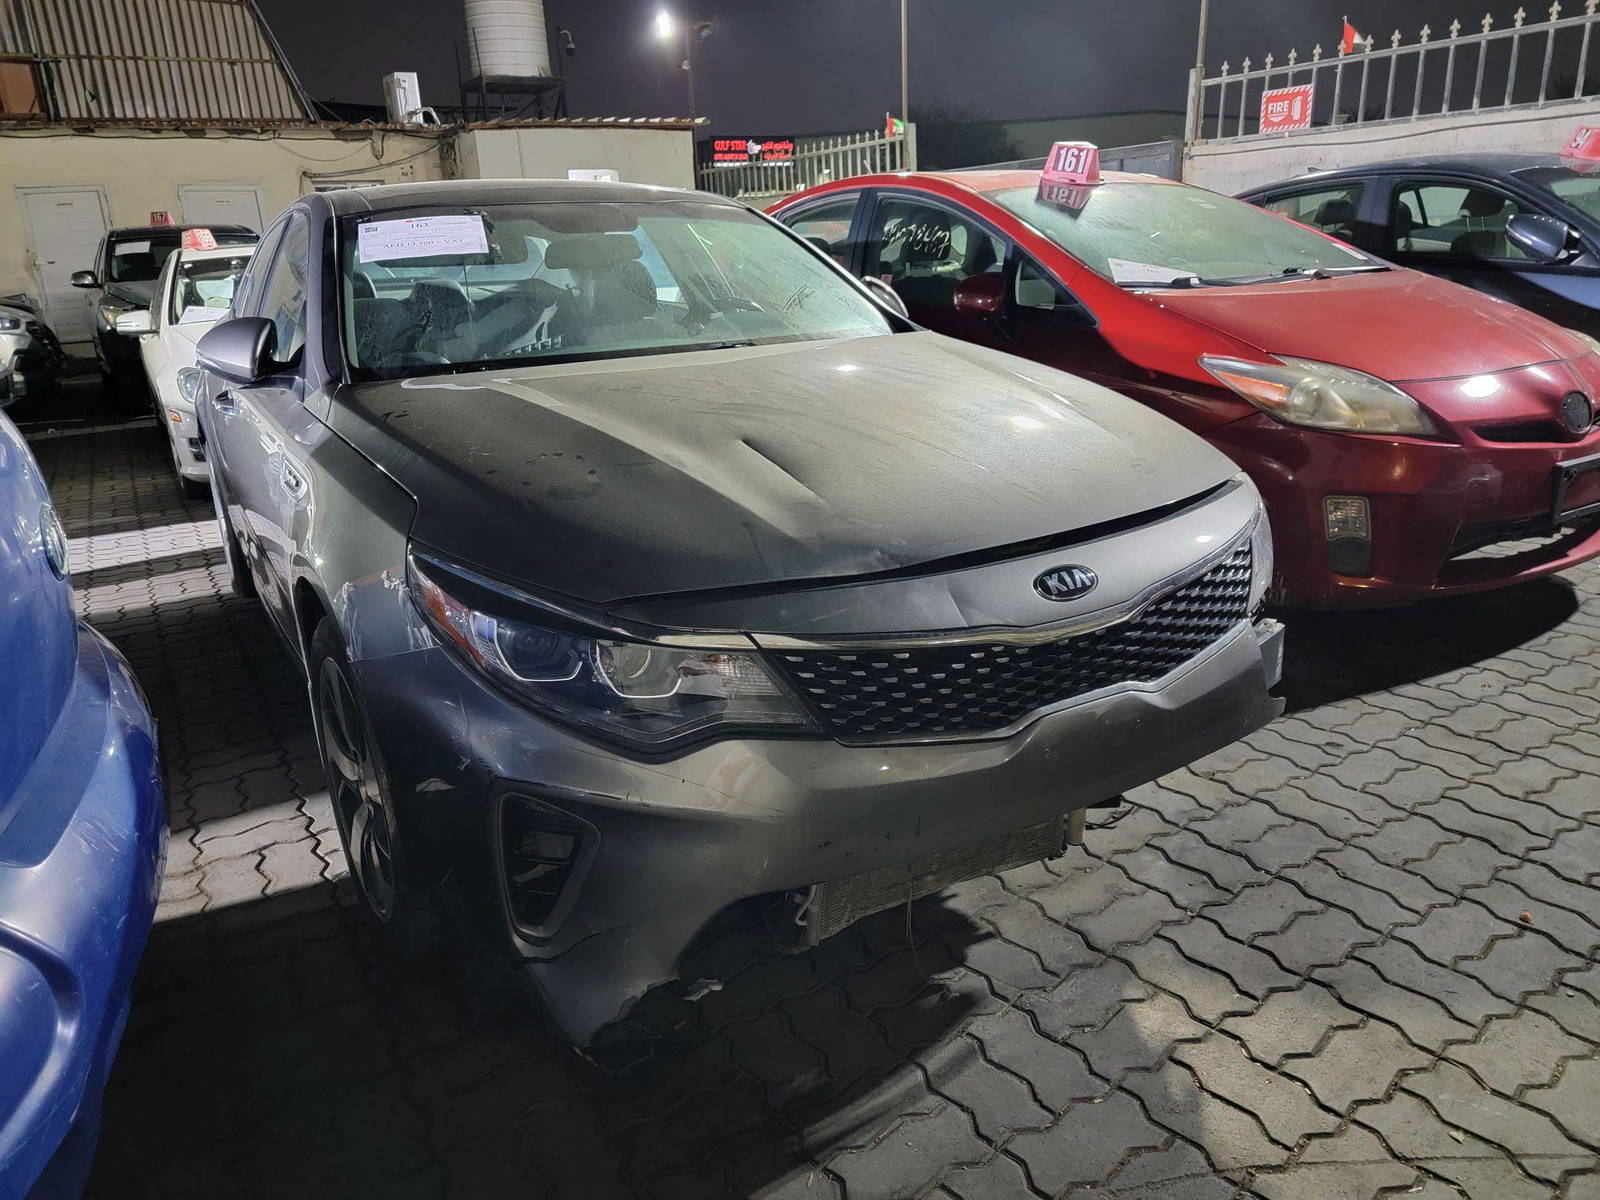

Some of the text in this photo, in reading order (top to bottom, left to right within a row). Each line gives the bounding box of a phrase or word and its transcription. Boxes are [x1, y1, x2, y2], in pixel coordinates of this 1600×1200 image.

[1267, 100, 1289, 114] FIRE
[1057, 147, 1088, 174] 161
[1043, 569, 1092, 594] KIA
